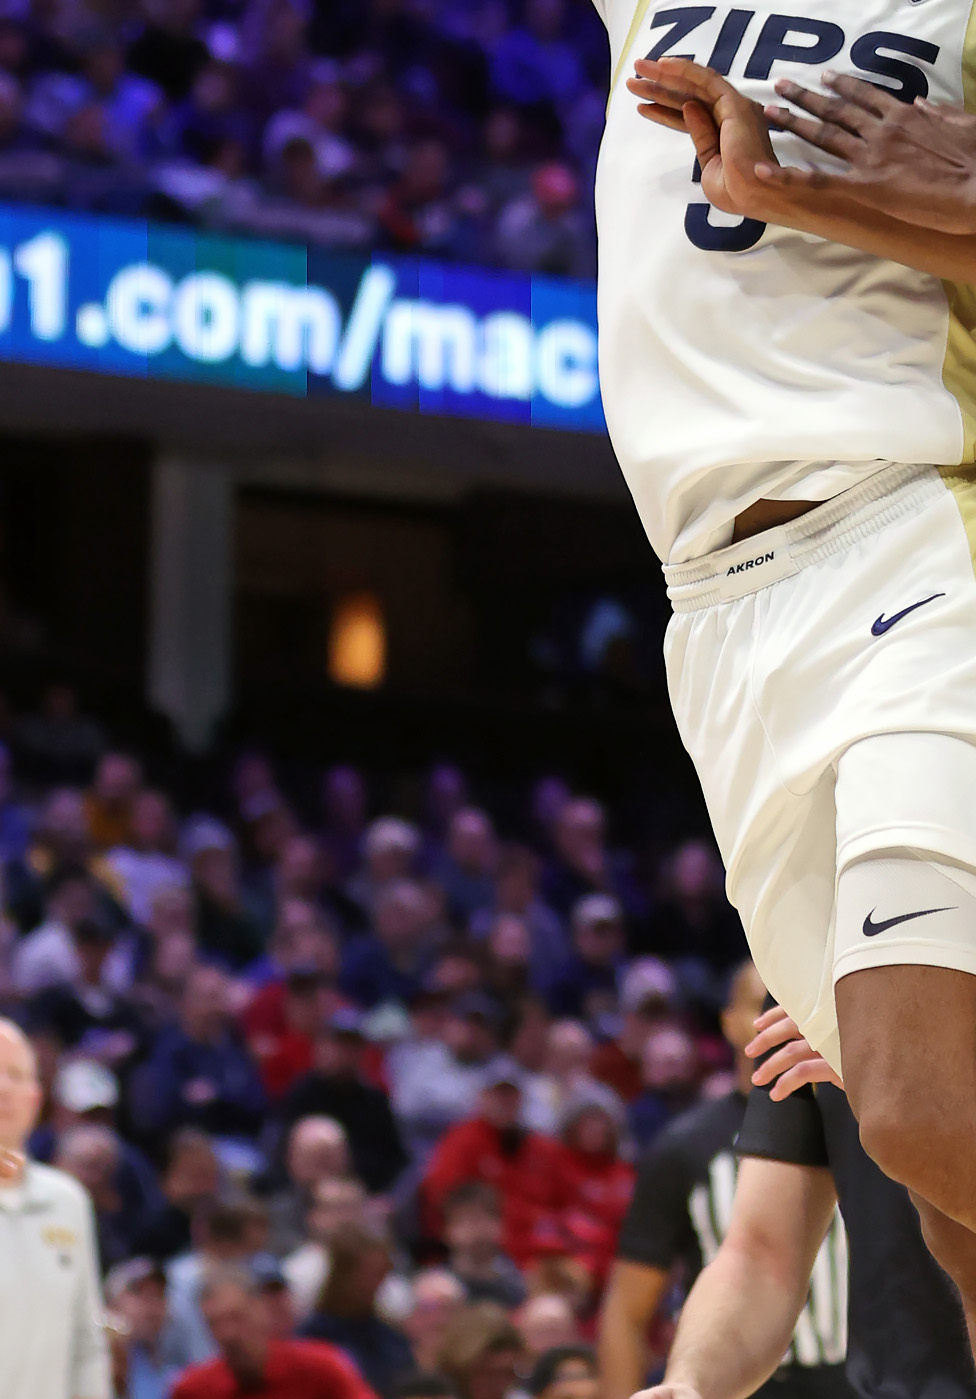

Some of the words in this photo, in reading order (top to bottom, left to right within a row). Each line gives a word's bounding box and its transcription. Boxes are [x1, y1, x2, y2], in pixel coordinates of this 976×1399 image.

[634, 5, 940, 104] ZIPS
[0, 230, 599, 408] 1.com/mac
[727, 551, 775, 576] AKRON
